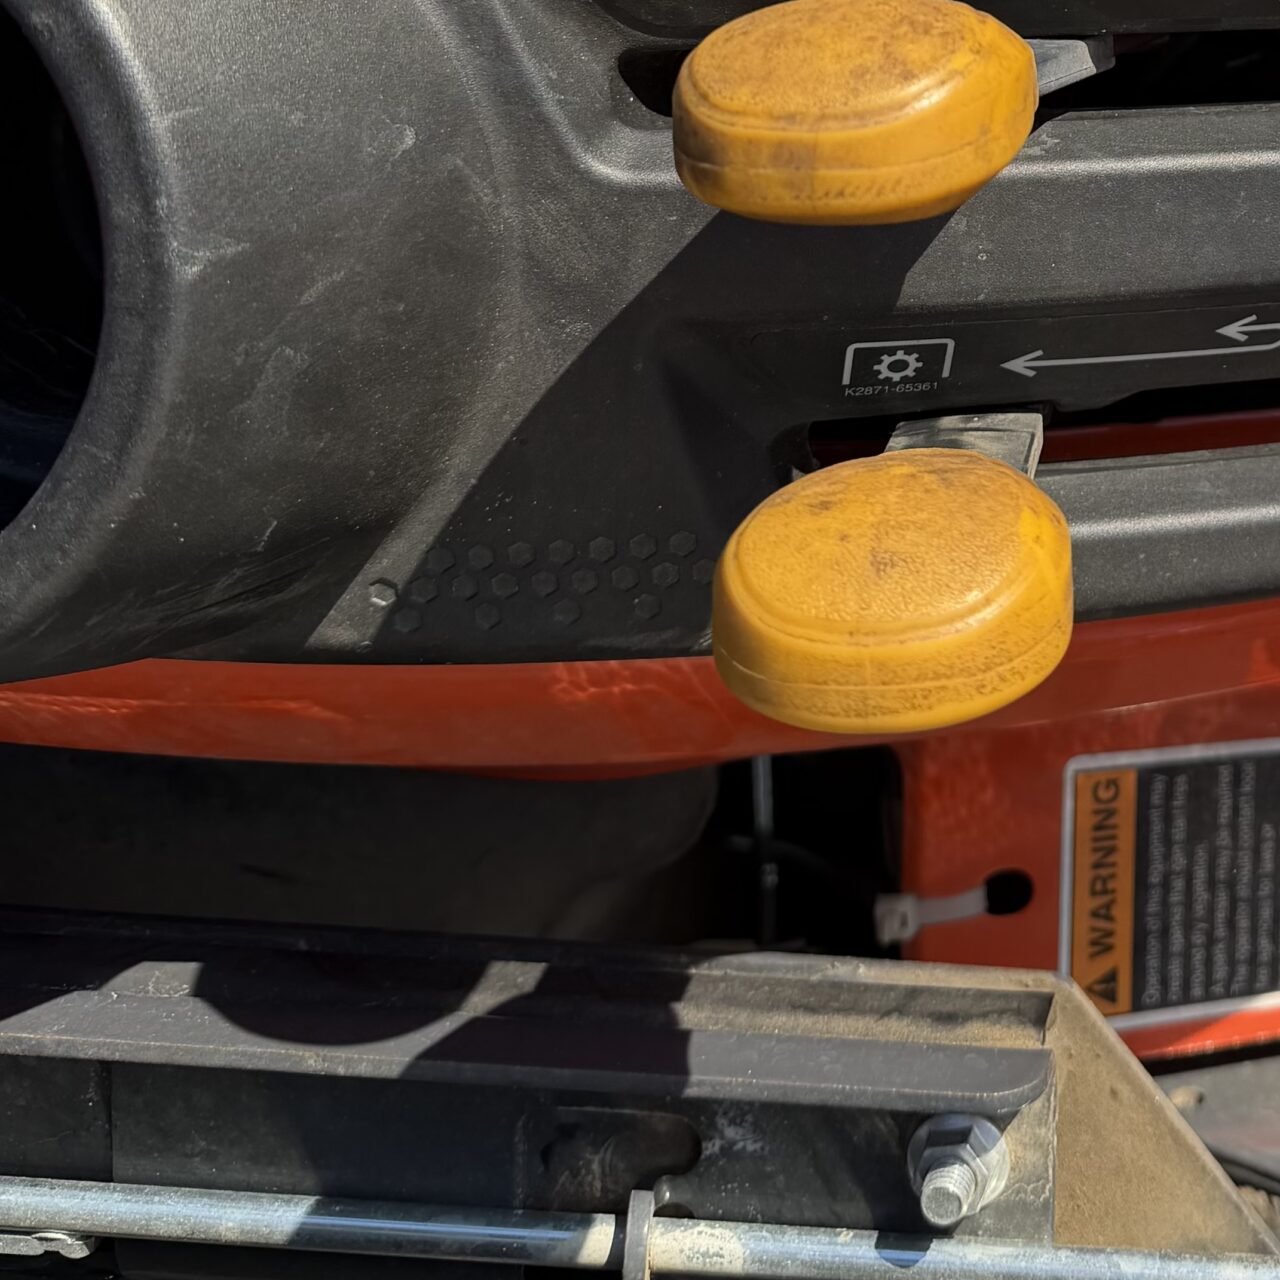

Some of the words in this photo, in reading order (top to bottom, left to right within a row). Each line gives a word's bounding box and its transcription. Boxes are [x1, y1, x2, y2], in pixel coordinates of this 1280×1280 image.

[845, 382, 938, 397] K2871-65361
[1149, 773, 1169, 806] may
[1147, 807, 1167, 884] equipment
[1090, 777, 1120, 959] WARNING
[1145, 886, 1162, 915] this
[1169, 874, 1186, 903] that
[1145, 917, 1161, 932] of
[1169, 904, 1186, 954] sparks
[1142, 934, 1162, 1004] Operation
[1190, 947, 1207, 999] around
[1209, 982, 1224, 996] A
